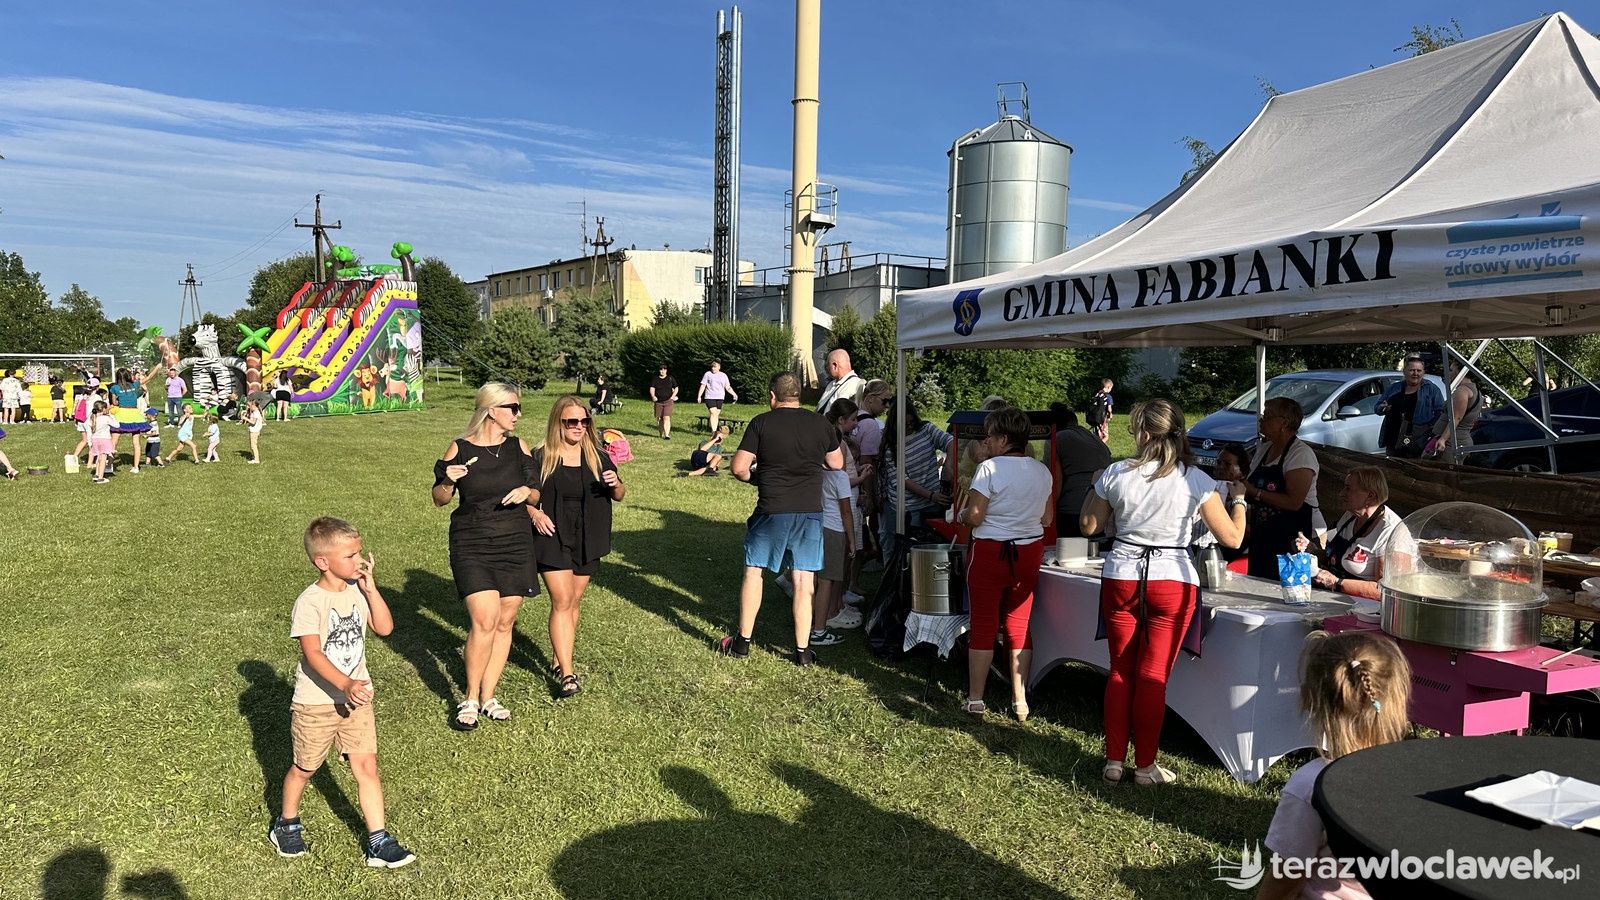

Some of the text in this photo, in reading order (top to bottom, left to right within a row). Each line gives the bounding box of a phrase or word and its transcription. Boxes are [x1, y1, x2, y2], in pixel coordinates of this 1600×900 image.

[1446, 235, 1584, 259] czyste powietrze
[1002, 229, 1398, 322] GMINA FABIANKI
[1444, 251, 1581, 277] zdrowy wybór
